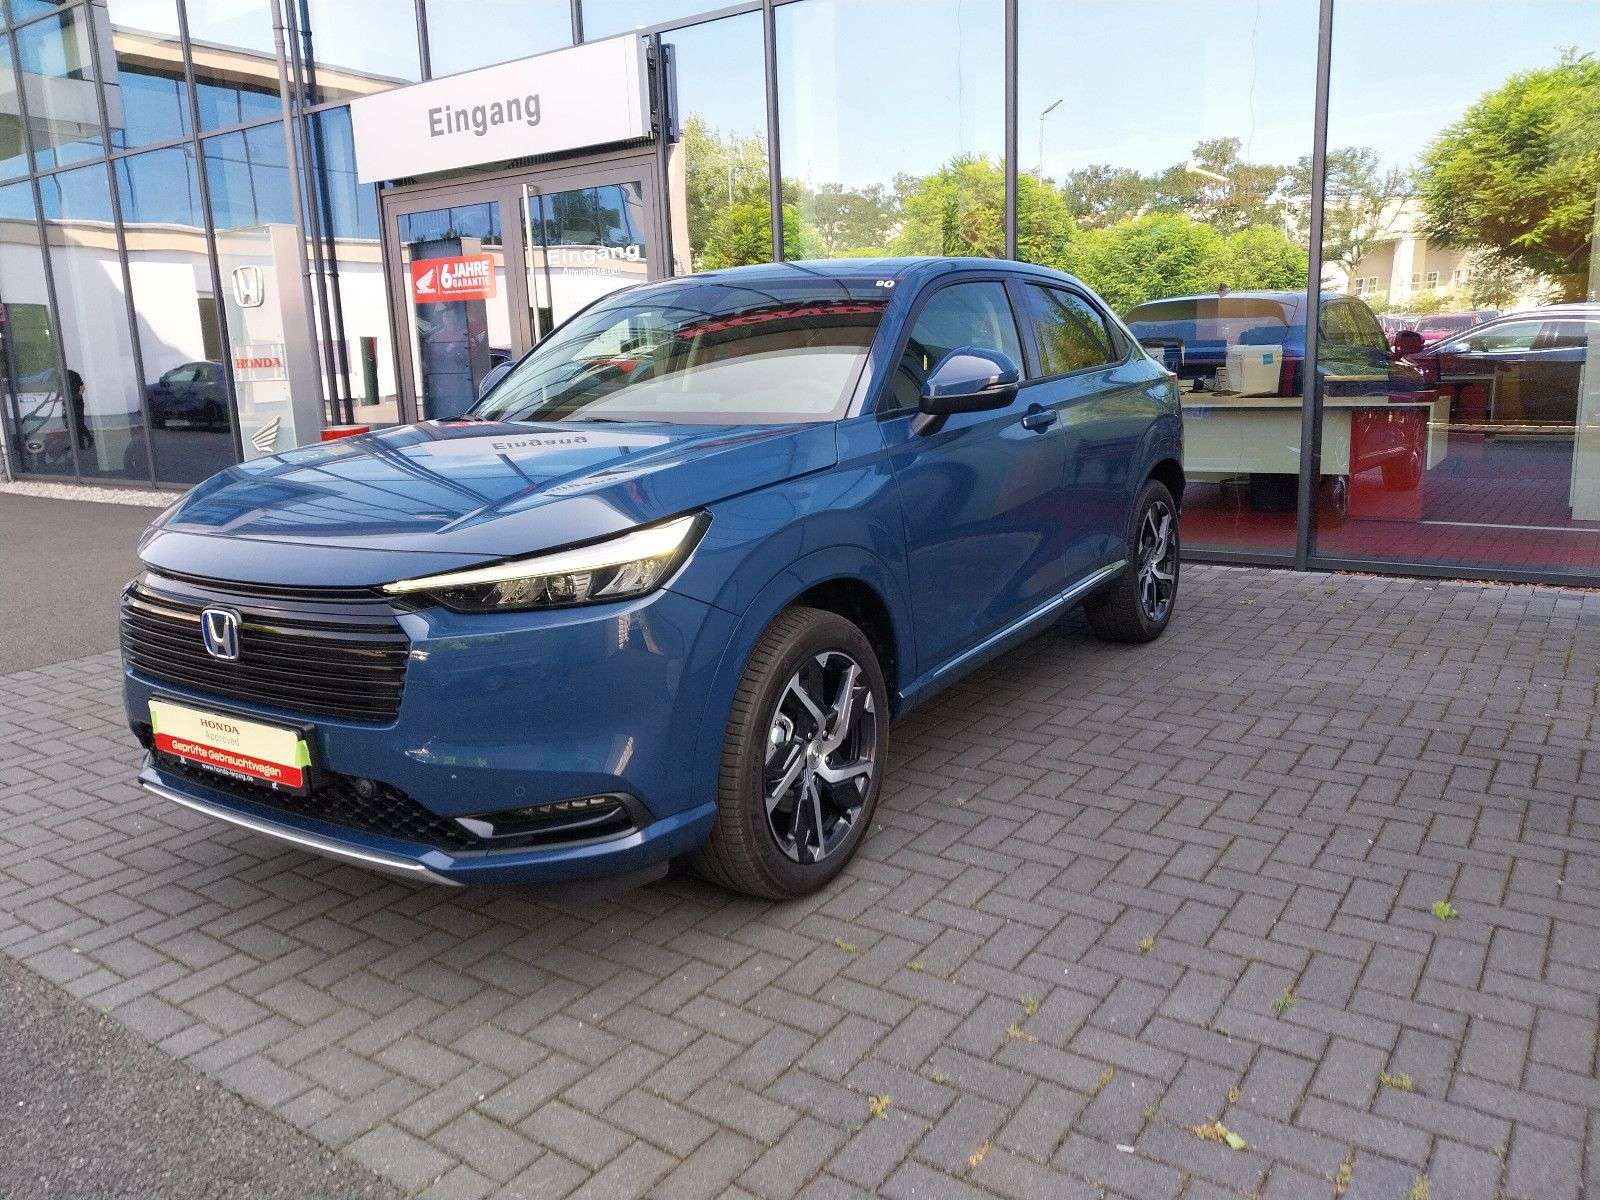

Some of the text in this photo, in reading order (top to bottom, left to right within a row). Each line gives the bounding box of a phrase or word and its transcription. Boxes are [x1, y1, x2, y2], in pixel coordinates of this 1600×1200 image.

[429, 94, 541, 138] Eingang
[547, 244, 640, 268] Eingang
[440, 260, 489, 289] 6 JAHRE
[235, 356, 282, 369] HONDA
[200, 718, 240, 735] HONDA
[171, 739, 282, 777] Geprüfte Gebrauchtwagen
